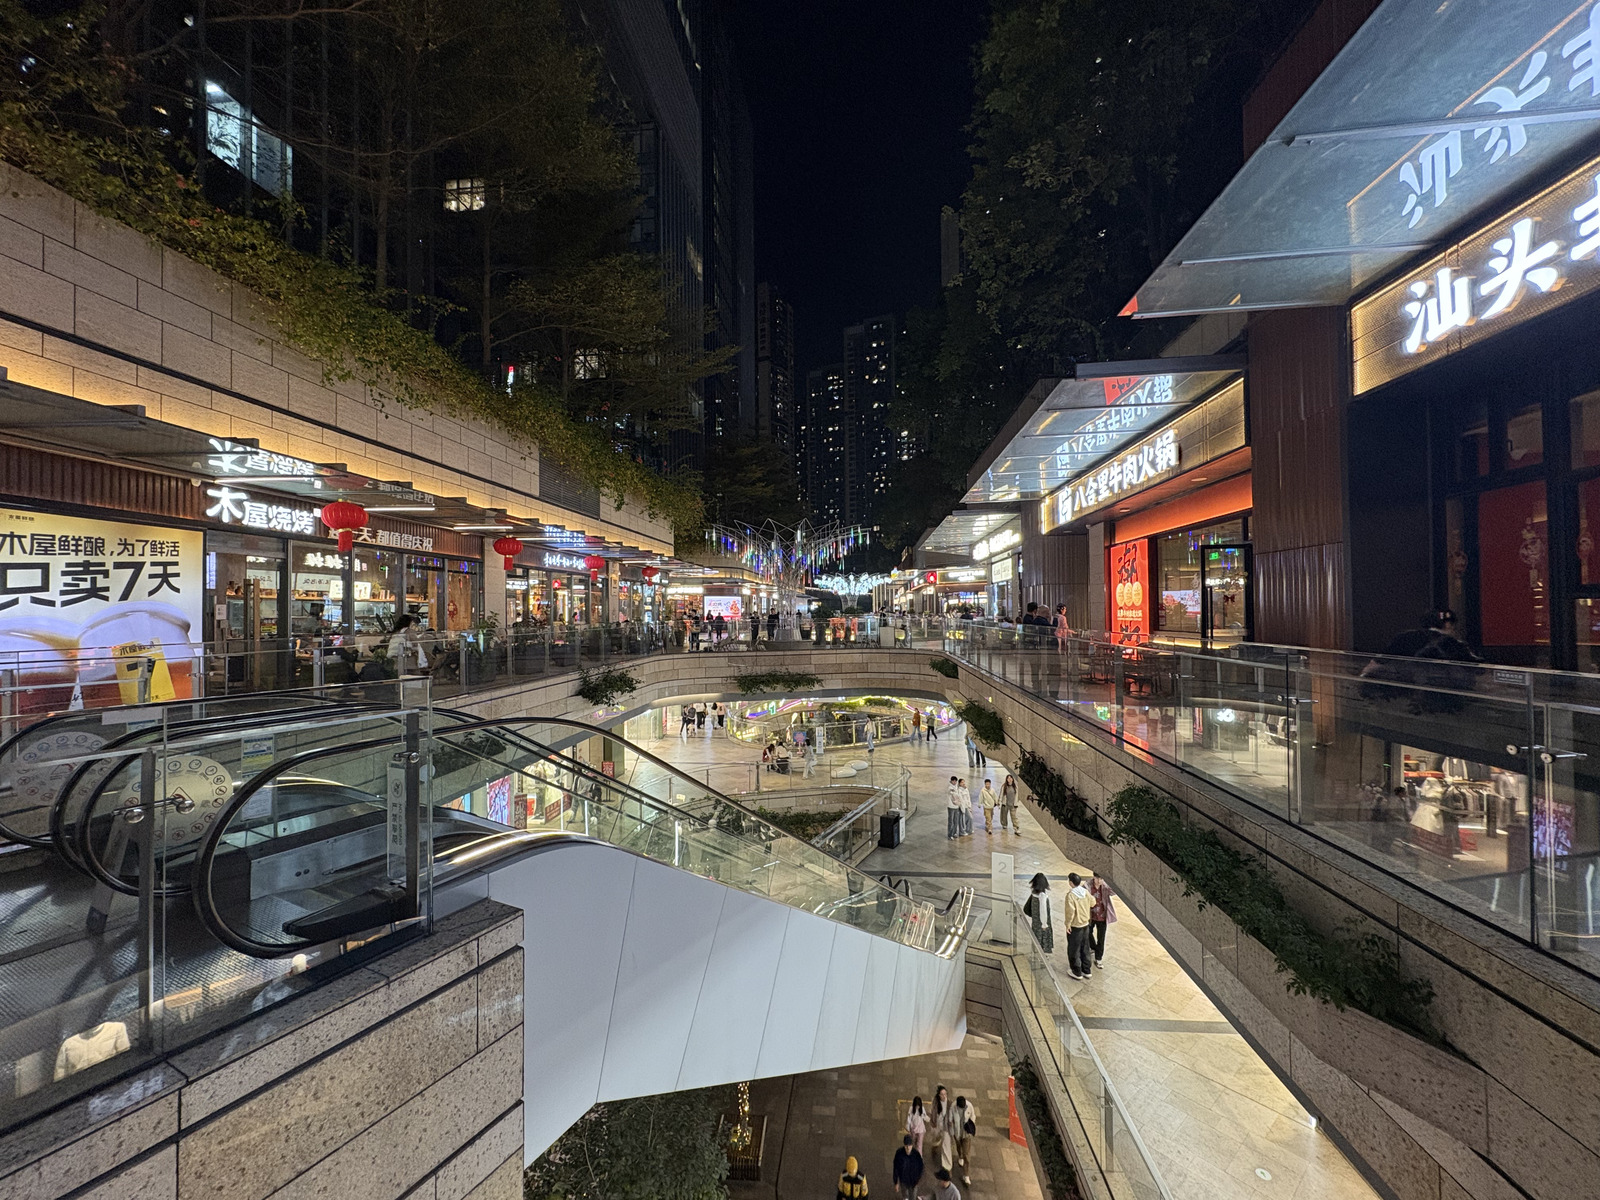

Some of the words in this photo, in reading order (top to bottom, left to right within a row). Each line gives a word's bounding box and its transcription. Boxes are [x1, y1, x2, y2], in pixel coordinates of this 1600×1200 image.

[1074, 429, 1178, 511] 八合里牛肉火锅
[206, 486, 315, 534] 木屋烧烤
[0, 559, 181, 612] 只卖7天
[998, 861, 1008, 874] 2
